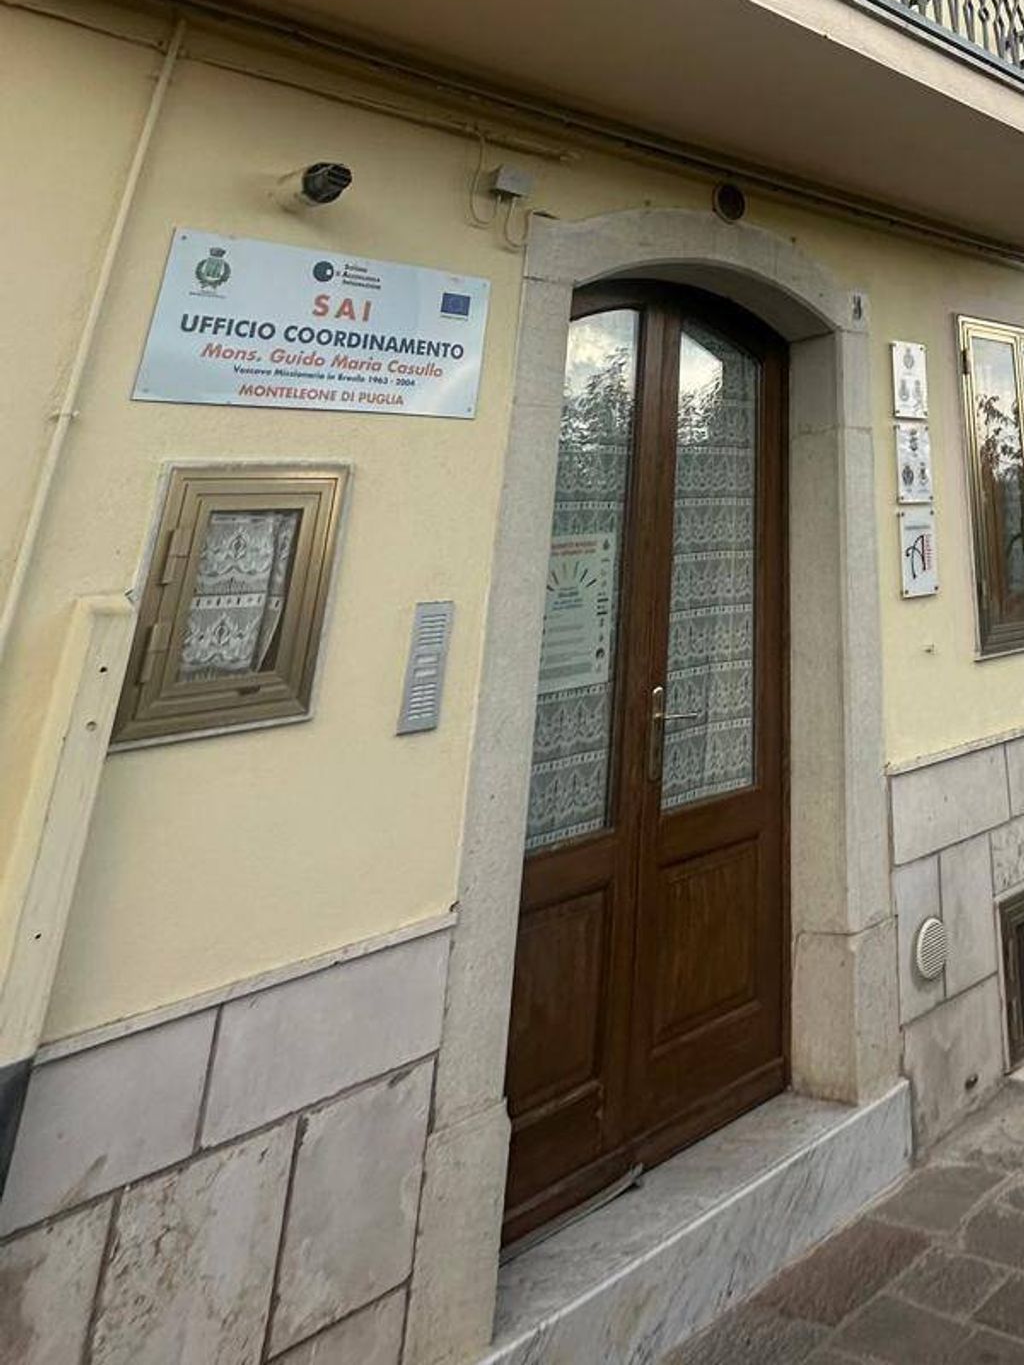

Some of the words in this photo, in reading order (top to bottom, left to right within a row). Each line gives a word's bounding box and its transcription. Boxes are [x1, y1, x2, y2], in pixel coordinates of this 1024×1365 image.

[312, 294, 372, 323] SAI
[180, 314, 276, 340] UFFICIO
[283, 325, 464, 360] COORDINAMENTO
[200, 342, 262, 362] Mons.
[270, 348, 326, 367] Guido
[331, 353, 382, 372] Maria
[387, 359, 444, 378] Casullo
[239, 384, 337, 402] MONTELEONE
[341, 391, 354, 402] DI
[357, 392, 405, 406] PUGLIA
